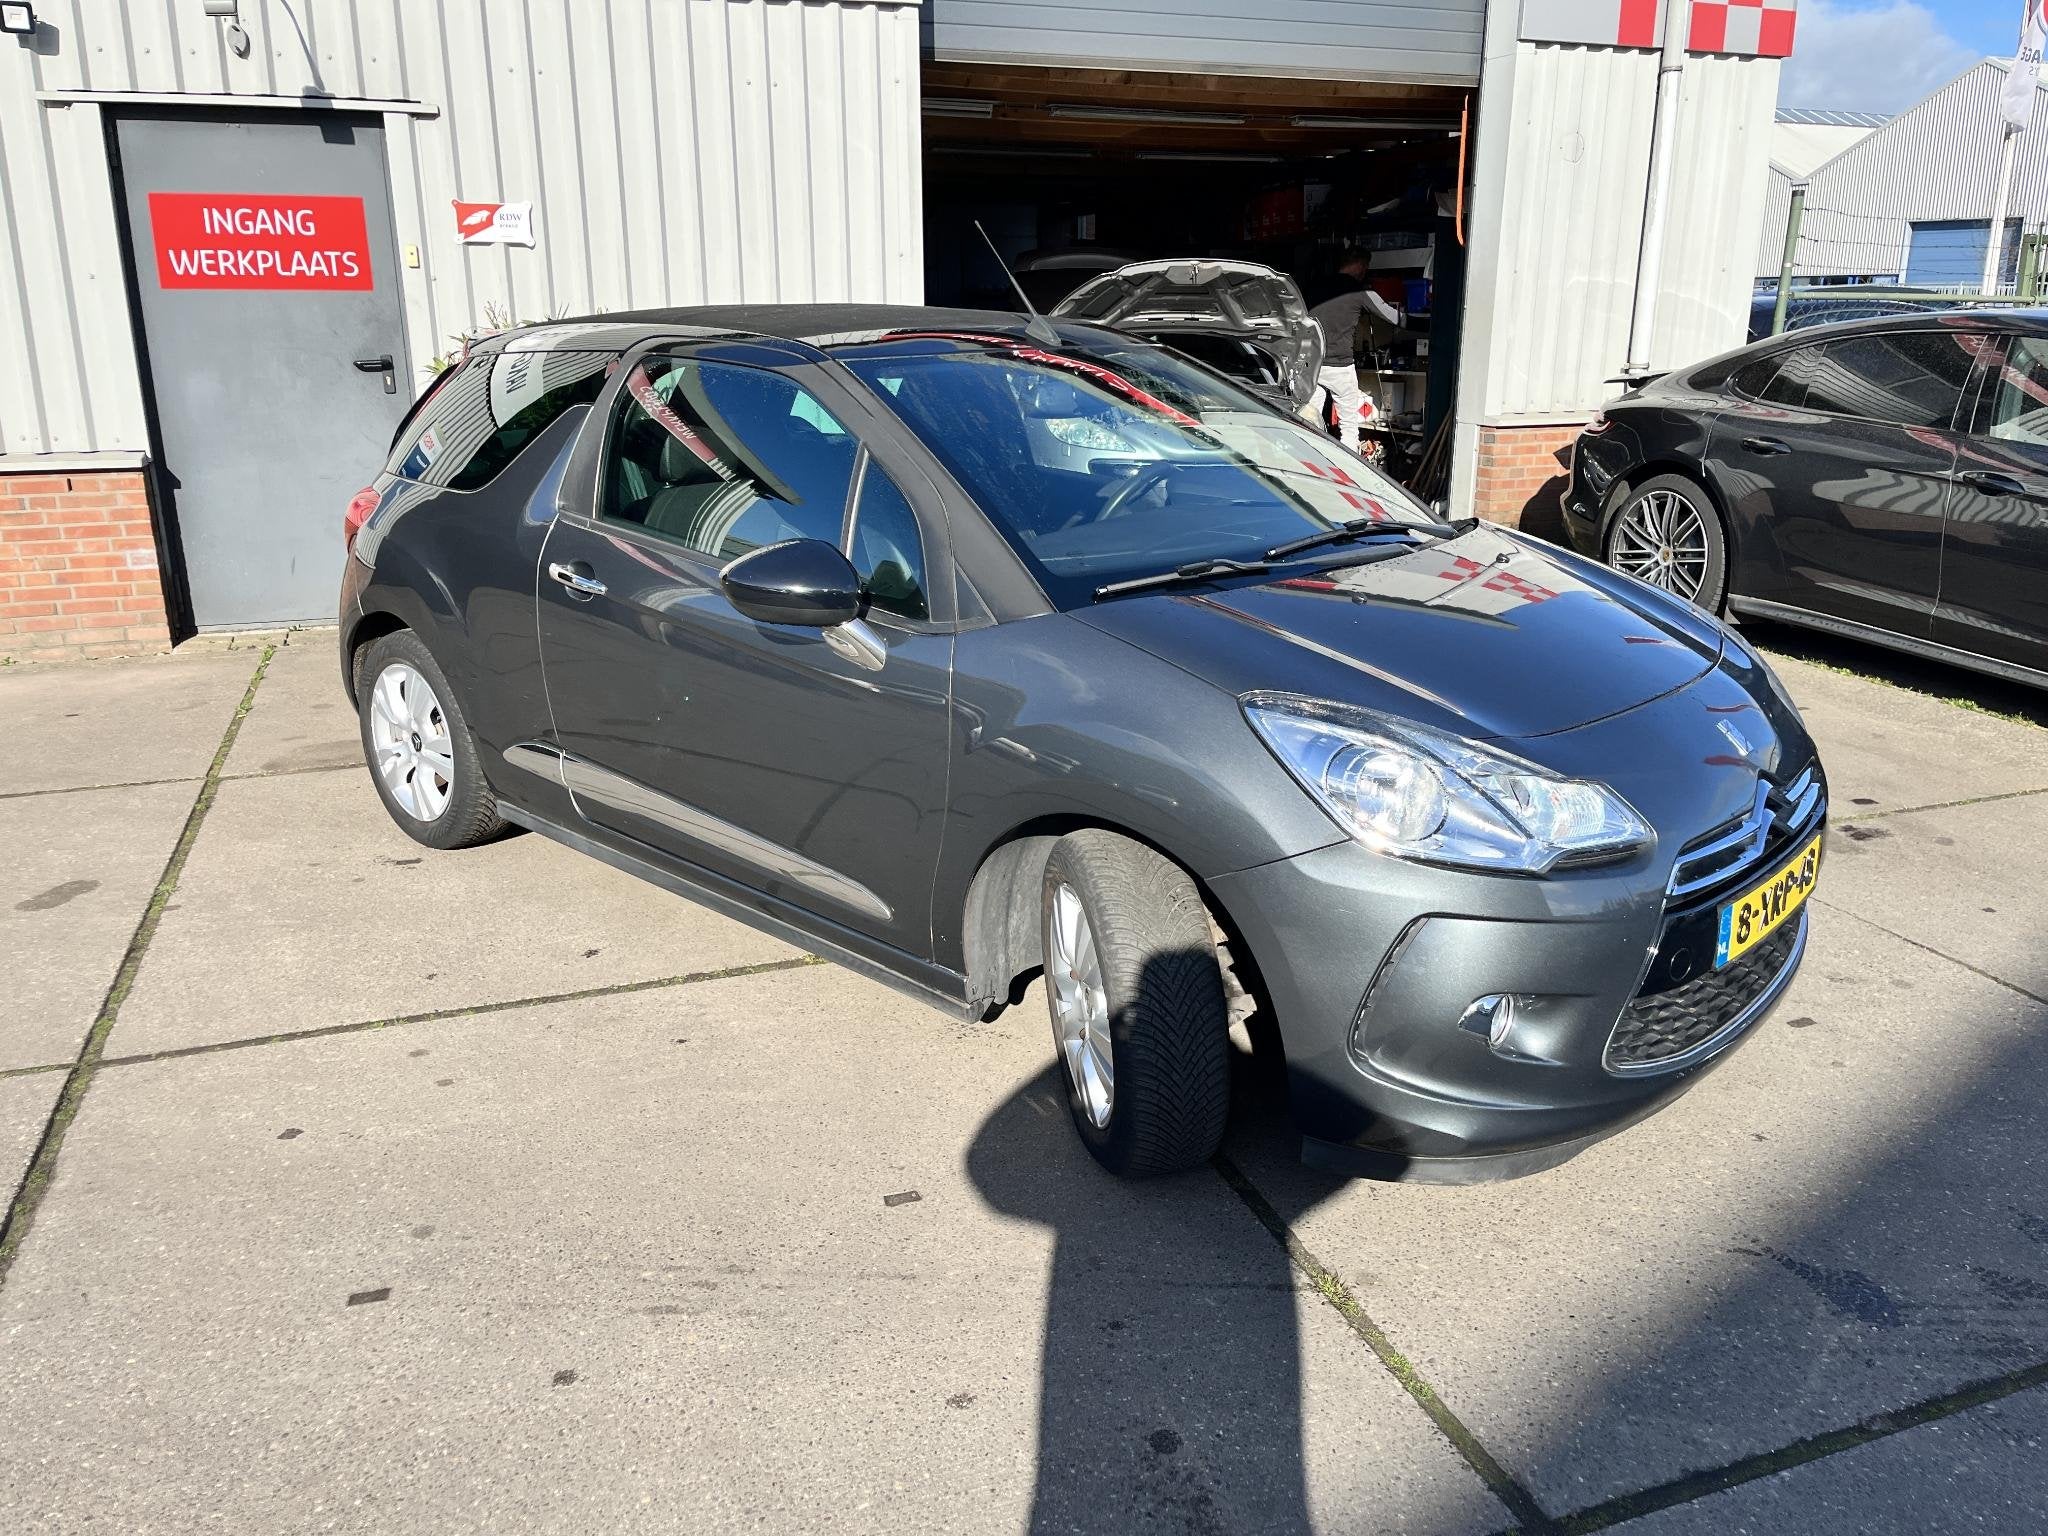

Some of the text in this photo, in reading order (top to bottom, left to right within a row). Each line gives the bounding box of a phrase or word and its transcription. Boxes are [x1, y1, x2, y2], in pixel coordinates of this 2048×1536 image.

[202, 207, 316, 236] INGANG
[499, 213, 522, 221] RDW
[168, 248, 360, 277] WERKPLAATS
[1717, 942, 1728, 955] NL
